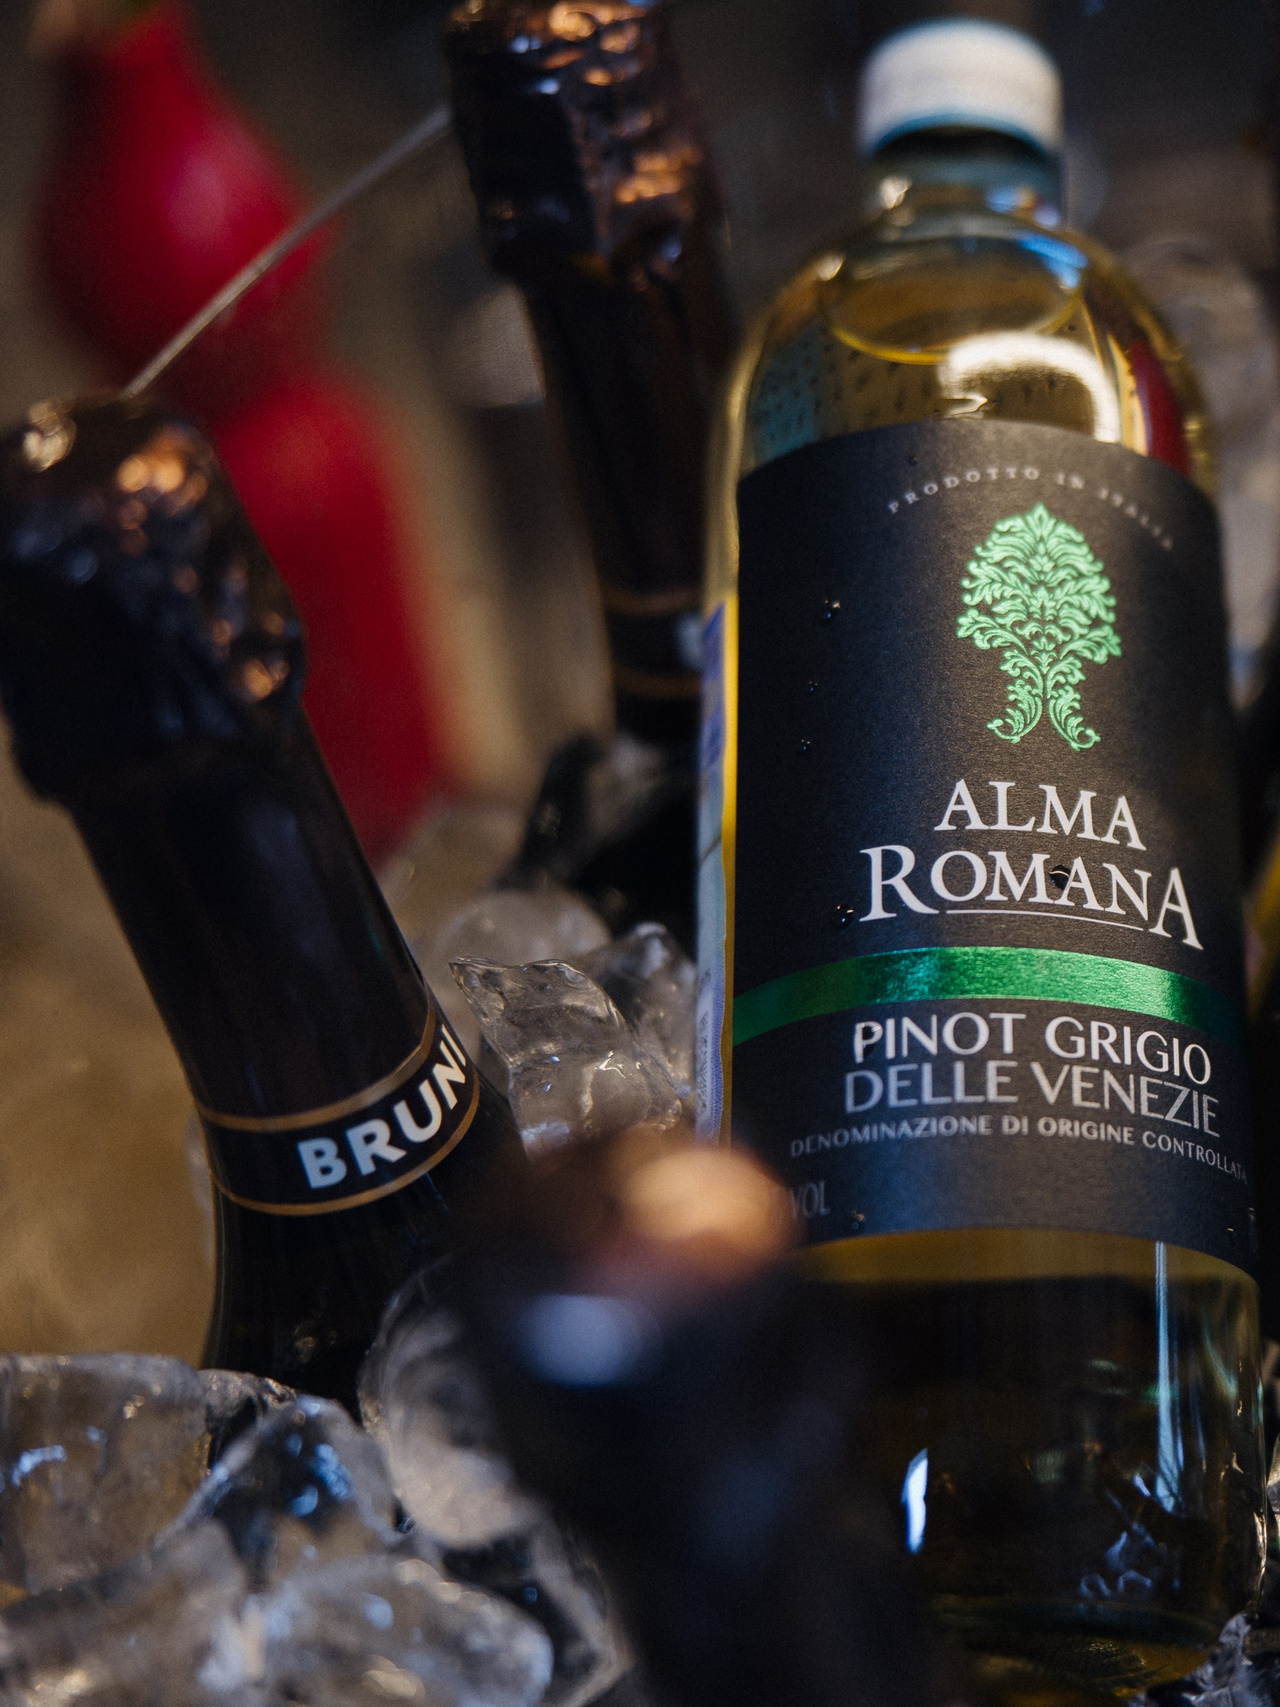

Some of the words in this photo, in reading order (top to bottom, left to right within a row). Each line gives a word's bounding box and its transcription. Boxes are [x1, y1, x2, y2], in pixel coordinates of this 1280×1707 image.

[888, 466, 1040, 515] PRODOTTO
[1055, 471, 1086, 490] IN
[934, 778, 1147, 851] ALMA
[859, 844, 1204, 951] ROMANA
[853, 1011, 1027, 1064] PINOT
[1044, 1015, 1212, 1086] GRIGIO
[297, 1023, 467, 1190] BRUNI
[845, 1060, 1019, 1115] DELLE
[1030, 1061, 1222, 1138] VENEZIE
[790, 1115, 993, 1159] DENOMINAZIONE
[1002, 1116, 1029, 1136] DI
[1037, 1115, 1135, 1146] ORIGINE
[1142, 1130, 1249, 1186] CONTROLLATA
